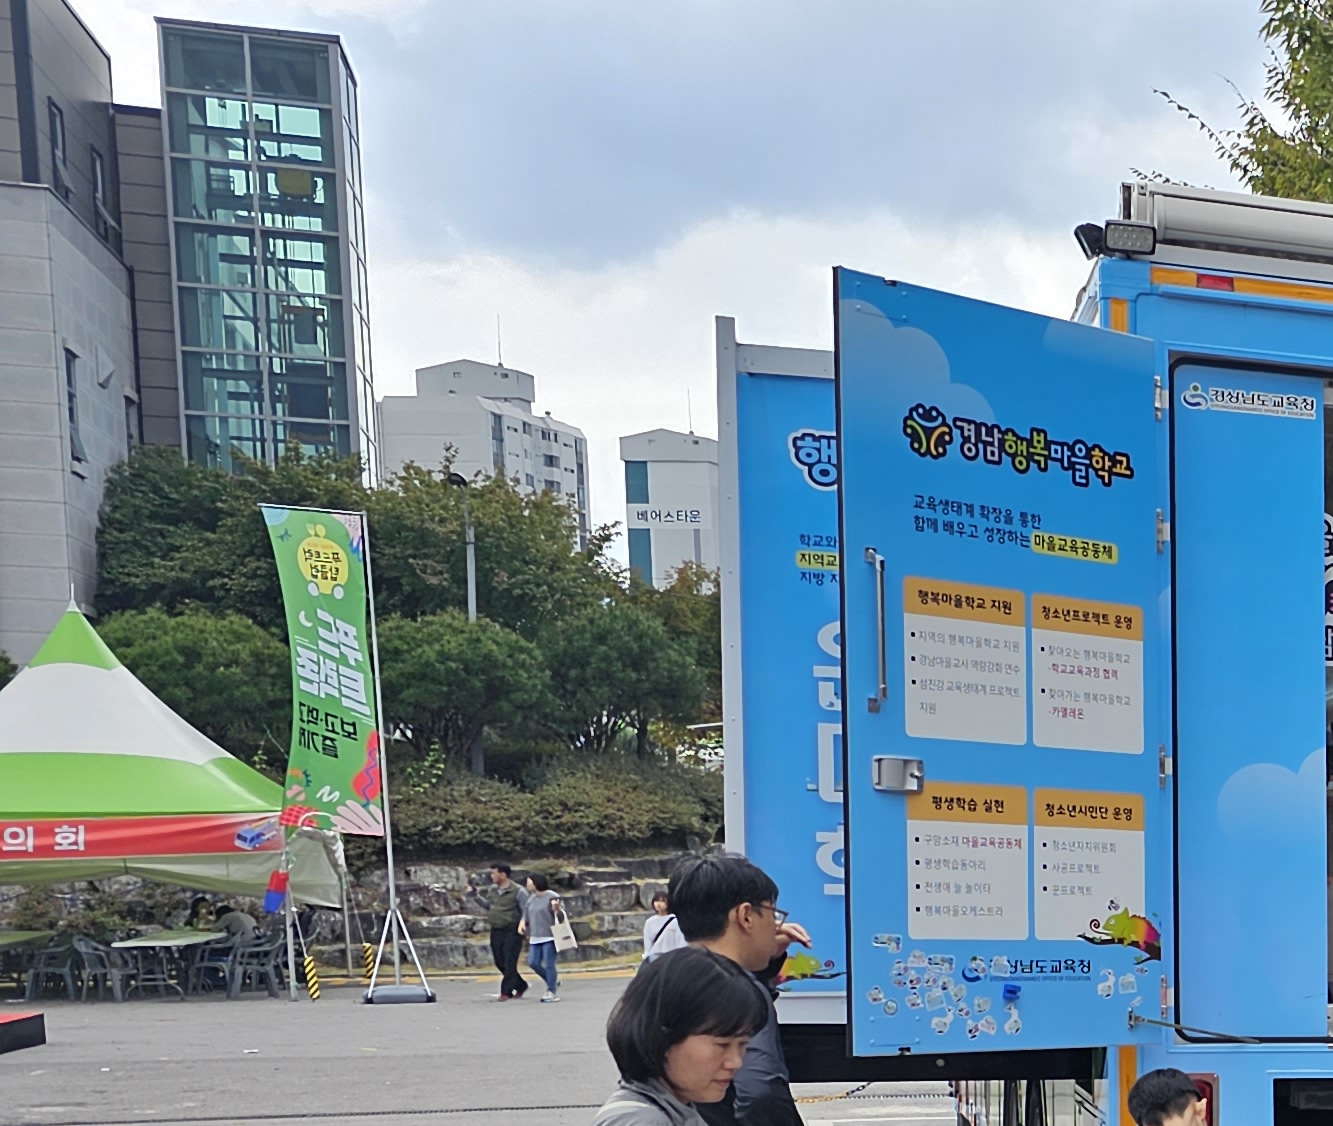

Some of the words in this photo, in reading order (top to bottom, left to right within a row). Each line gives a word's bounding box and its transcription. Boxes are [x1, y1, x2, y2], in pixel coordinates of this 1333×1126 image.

[1211, 389, 1314, 411] 경상남도교육청
[955, 419, 1132, 485] 경남행복마을학교
[636, 509, 701, 523] 베어스타운
[913, 495, 975, 518] 교육생태계
[979, 505, 1013, 525] 확장을
[1019, 513, 1041, 530] 통한
[913, 516, 938, 532] 함께
[943, 520, 979, 539] 배우고
[984, 527, 1030, 548] 성장하는
[1034, 534, 1113, 560] 마을교육공동체
[918, 590, 986, 610] 행복마을학교
[991, 599, 1012, 615] 지원
[1042, 606, 1110, 626] 청소년프로젝트
[1114, 615, 1132, 630] 운영
[919, 631, 945, 644] 지역의
[948, 634, 1000, 650] 행복마을학교
[1004, 640, 1020, 652] 지원
[1049, 645, 1080, 659] 찾아오는
[1083, 649, 1130, 664] 행복마을학교
[989, 684, 1020, 698] 프로젝트
[1049, 688, 1080, 702] 찾아가는
[1083, 692, 1130, 706] 행복마을학교
[920, 702, 936, 715] 지원
[932, 796, 978, 812] 평생학습
[983, 799, 1004, 813] 실현
[1045, 803, 1108, 818] 청소년시민단
[1112, 807, 1132, 821] 운영
[962, 836, 1022, 850] 마을교육공동체
[989, 958, 1091, 974] 상남도교육청
